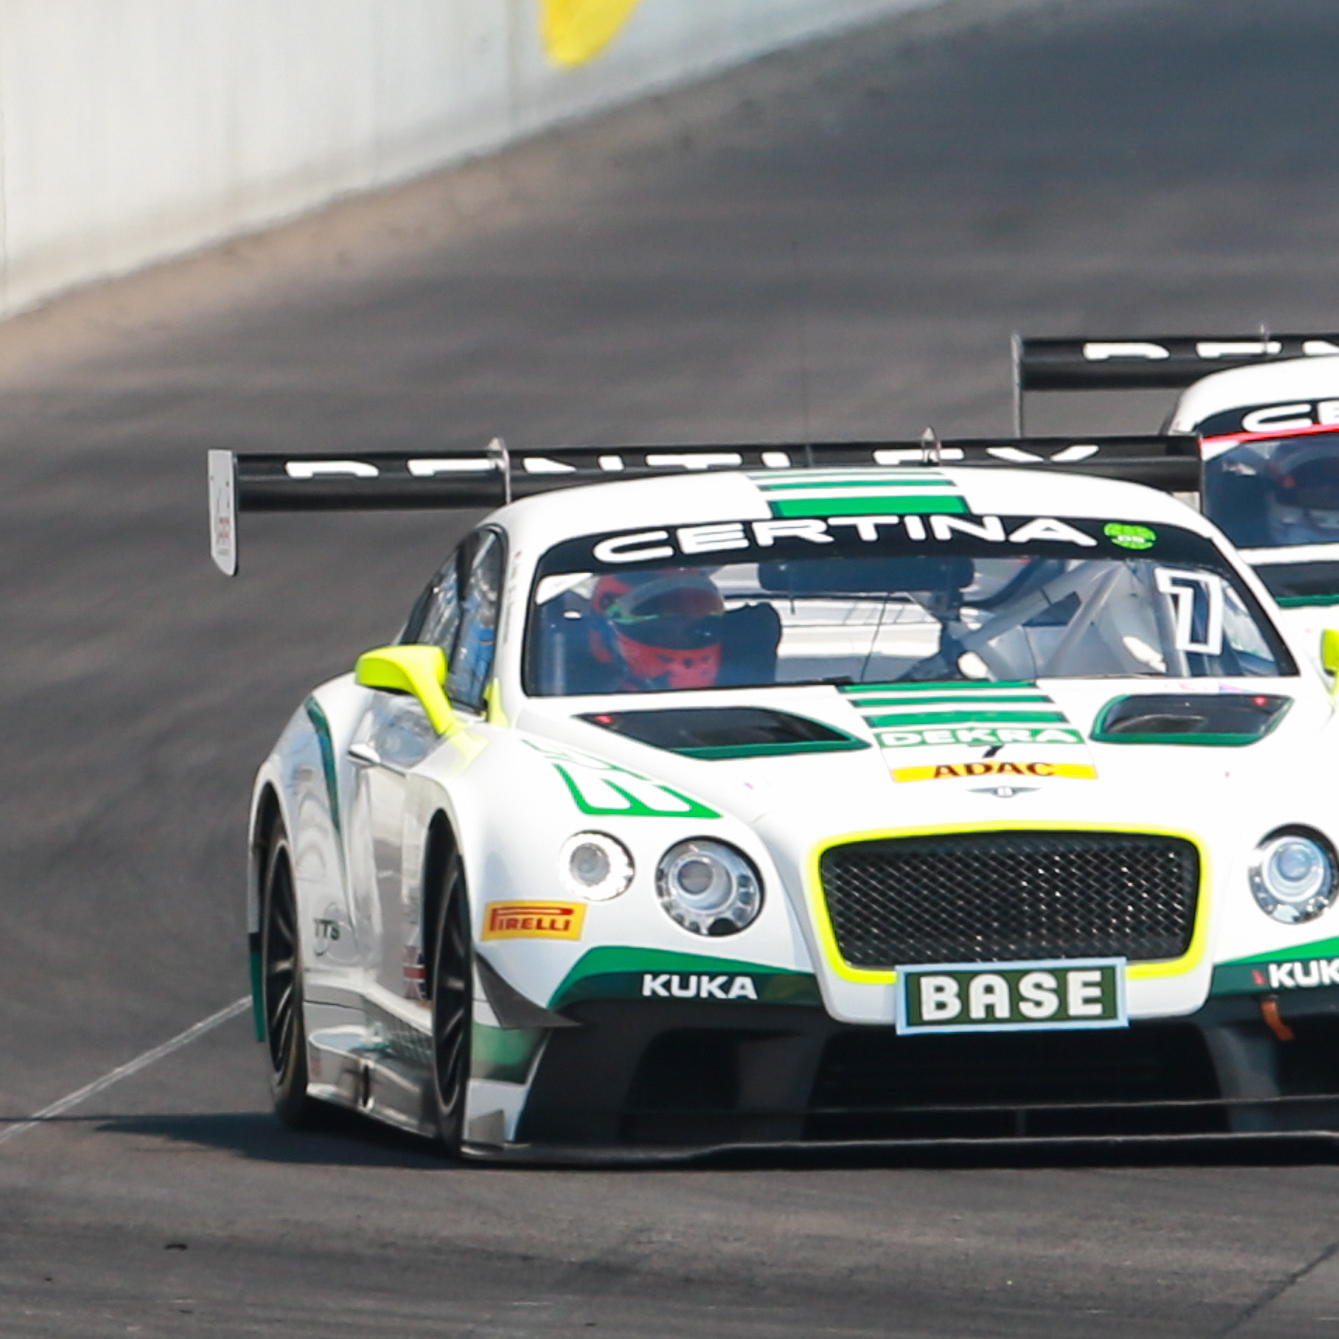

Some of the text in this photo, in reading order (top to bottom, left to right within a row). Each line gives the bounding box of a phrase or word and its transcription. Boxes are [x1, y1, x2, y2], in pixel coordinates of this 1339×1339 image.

[594, 515, 1098, 563] CERTINA
[879, 728, 1079, 747] DEKRA
[933, 762, 1055, 779] ADAC
[490, 906, 574, 932] PIRELLI
[642, 973, 758, 1000] KUKA
[920, 970, 1103, 1021] BASE
